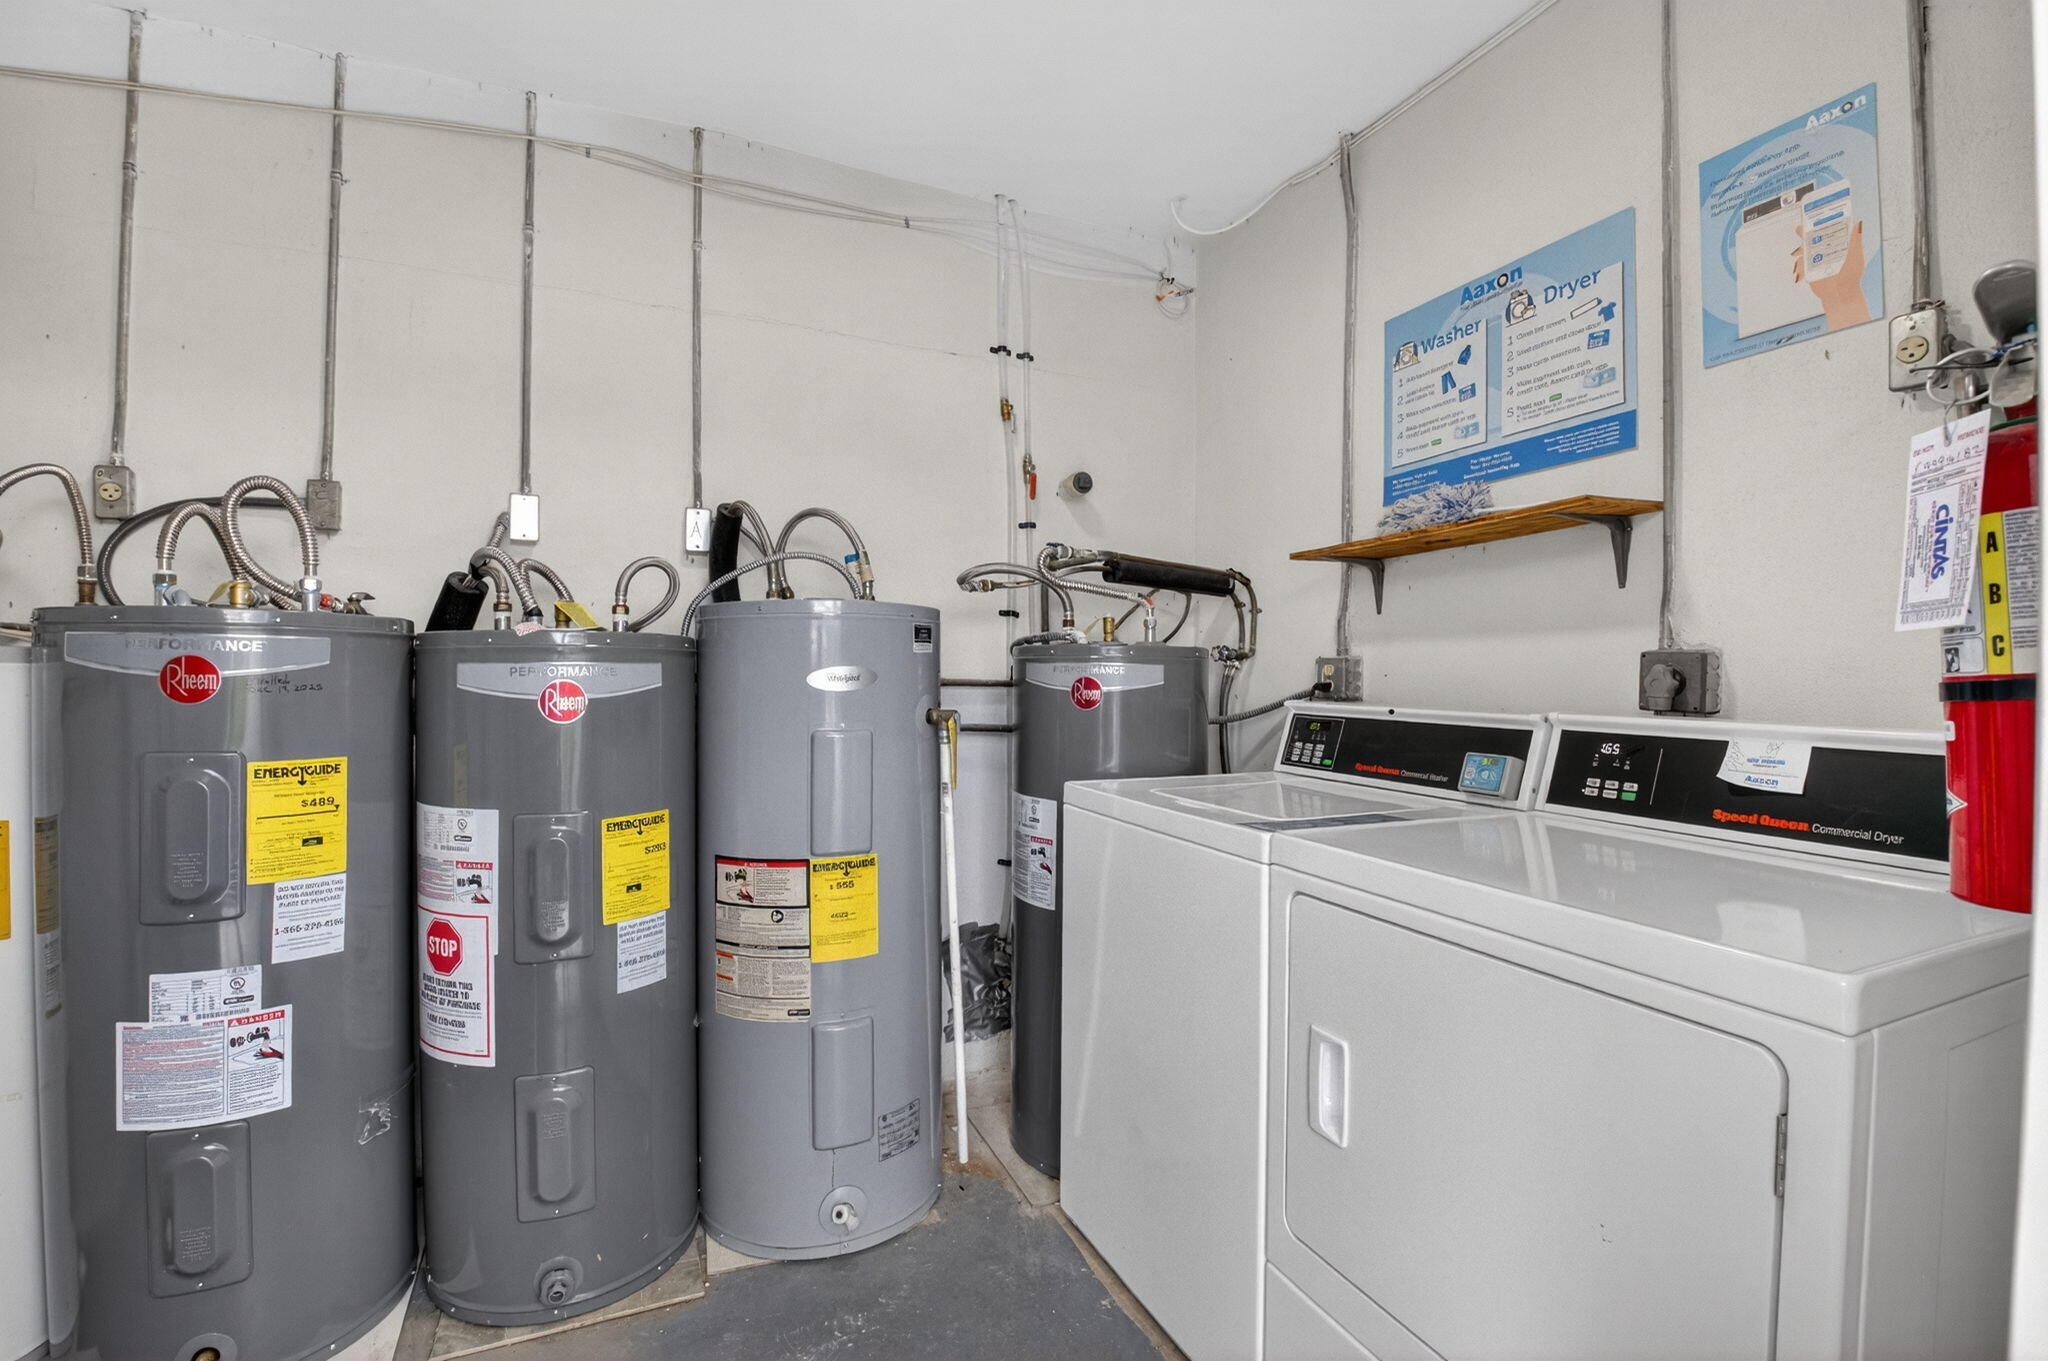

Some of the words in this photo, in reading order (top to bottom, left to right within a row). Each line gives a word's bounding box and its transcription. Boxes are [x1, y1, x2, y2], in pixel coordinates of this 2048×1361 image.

[1805, 95, 1866, 130] Aaxon
[1459, 267, 1523, 305] Aaxon
[1543, 268, 1602, 305] Dryer
[1420, 319, 1482, 354] Washer
[1986, 531, 1999, 554] A
[1988, 583, 2002, 605] B
[1992, 634, 2005, 657] C
[165, 655, 218, 697] Rheem
[545, 679, 587, 718] Rheem
[301, 796, 335, 808] $489
[1712, 803, 1758, 824] Speed
[1759, 814, 1810, 832] Queen
[1811, 823, 1872, 841] Commercial
[1873, 831, 1904, 846] Dryer
[428, 935, 458, 958] STOP
